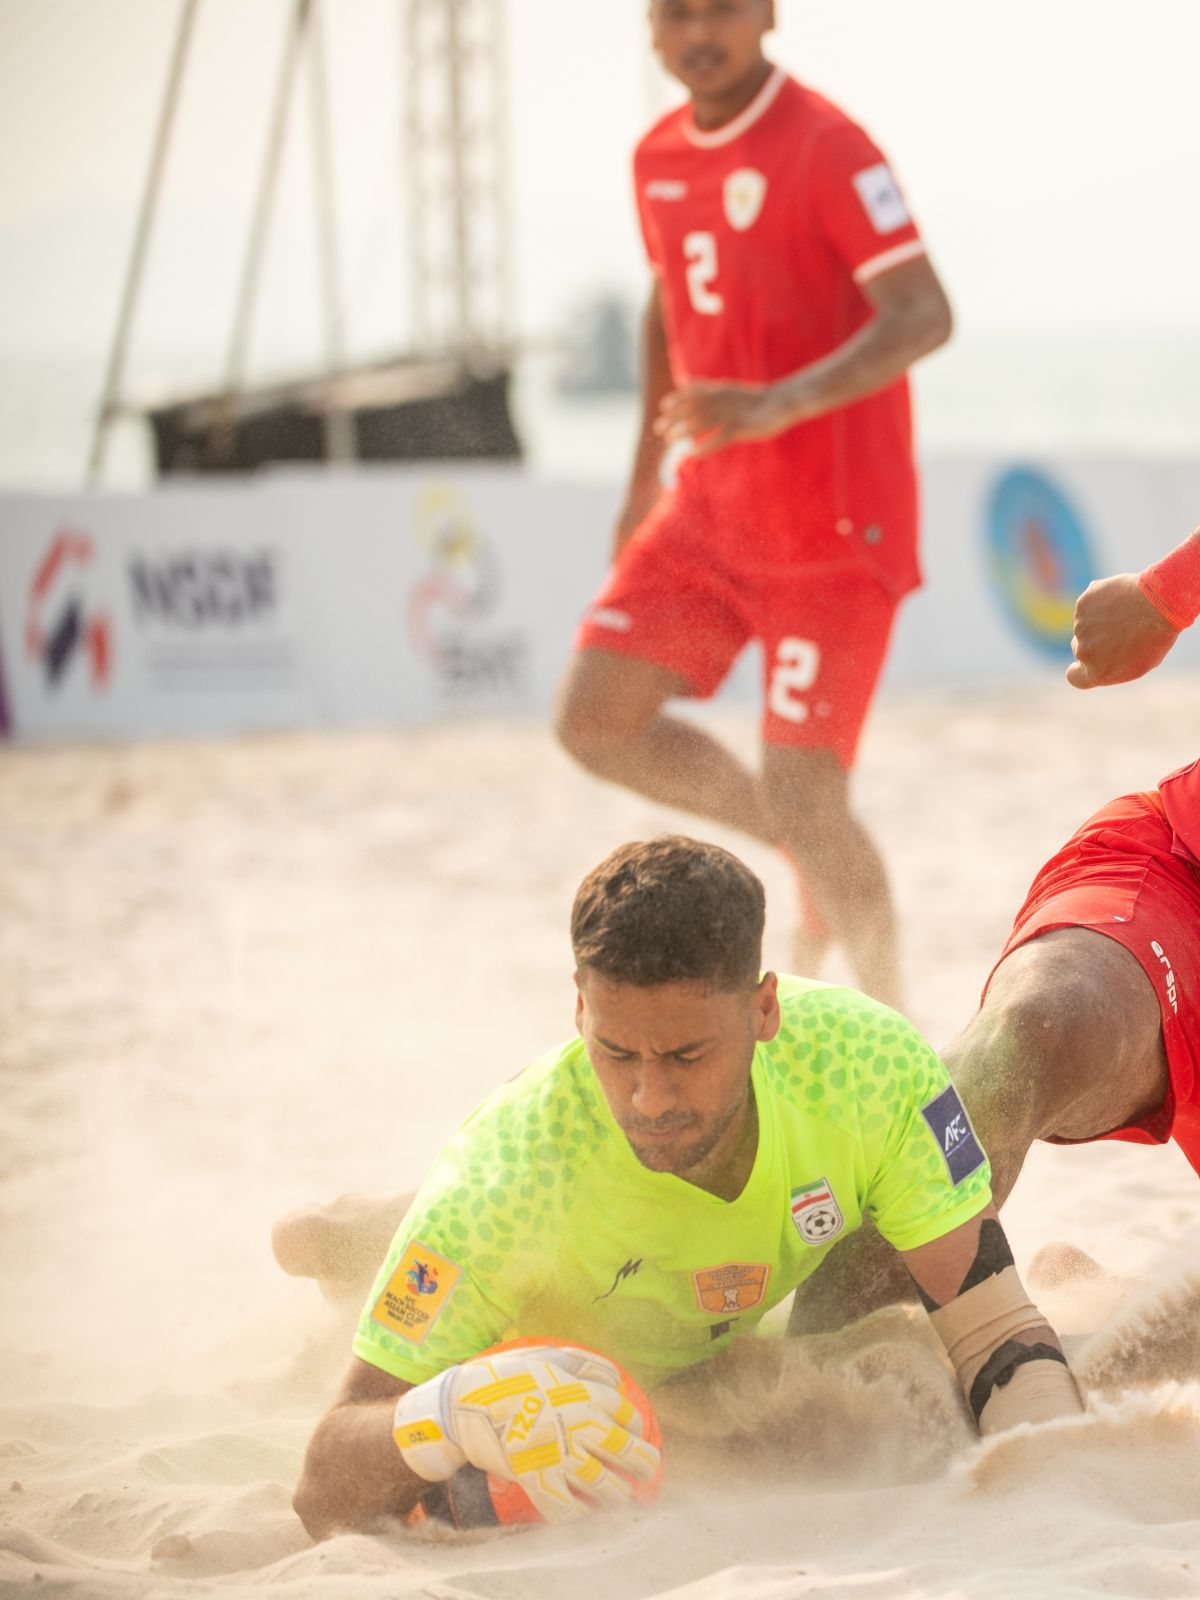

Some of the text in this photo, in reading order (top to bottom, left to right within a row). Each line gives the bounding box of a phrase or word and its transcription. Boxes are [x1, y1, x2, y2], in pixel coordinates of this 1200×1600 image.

[683, 231, 723, 315] 2
[769, 637, 820, 723] 2
[945, 1112, 967, 1152] AFC
